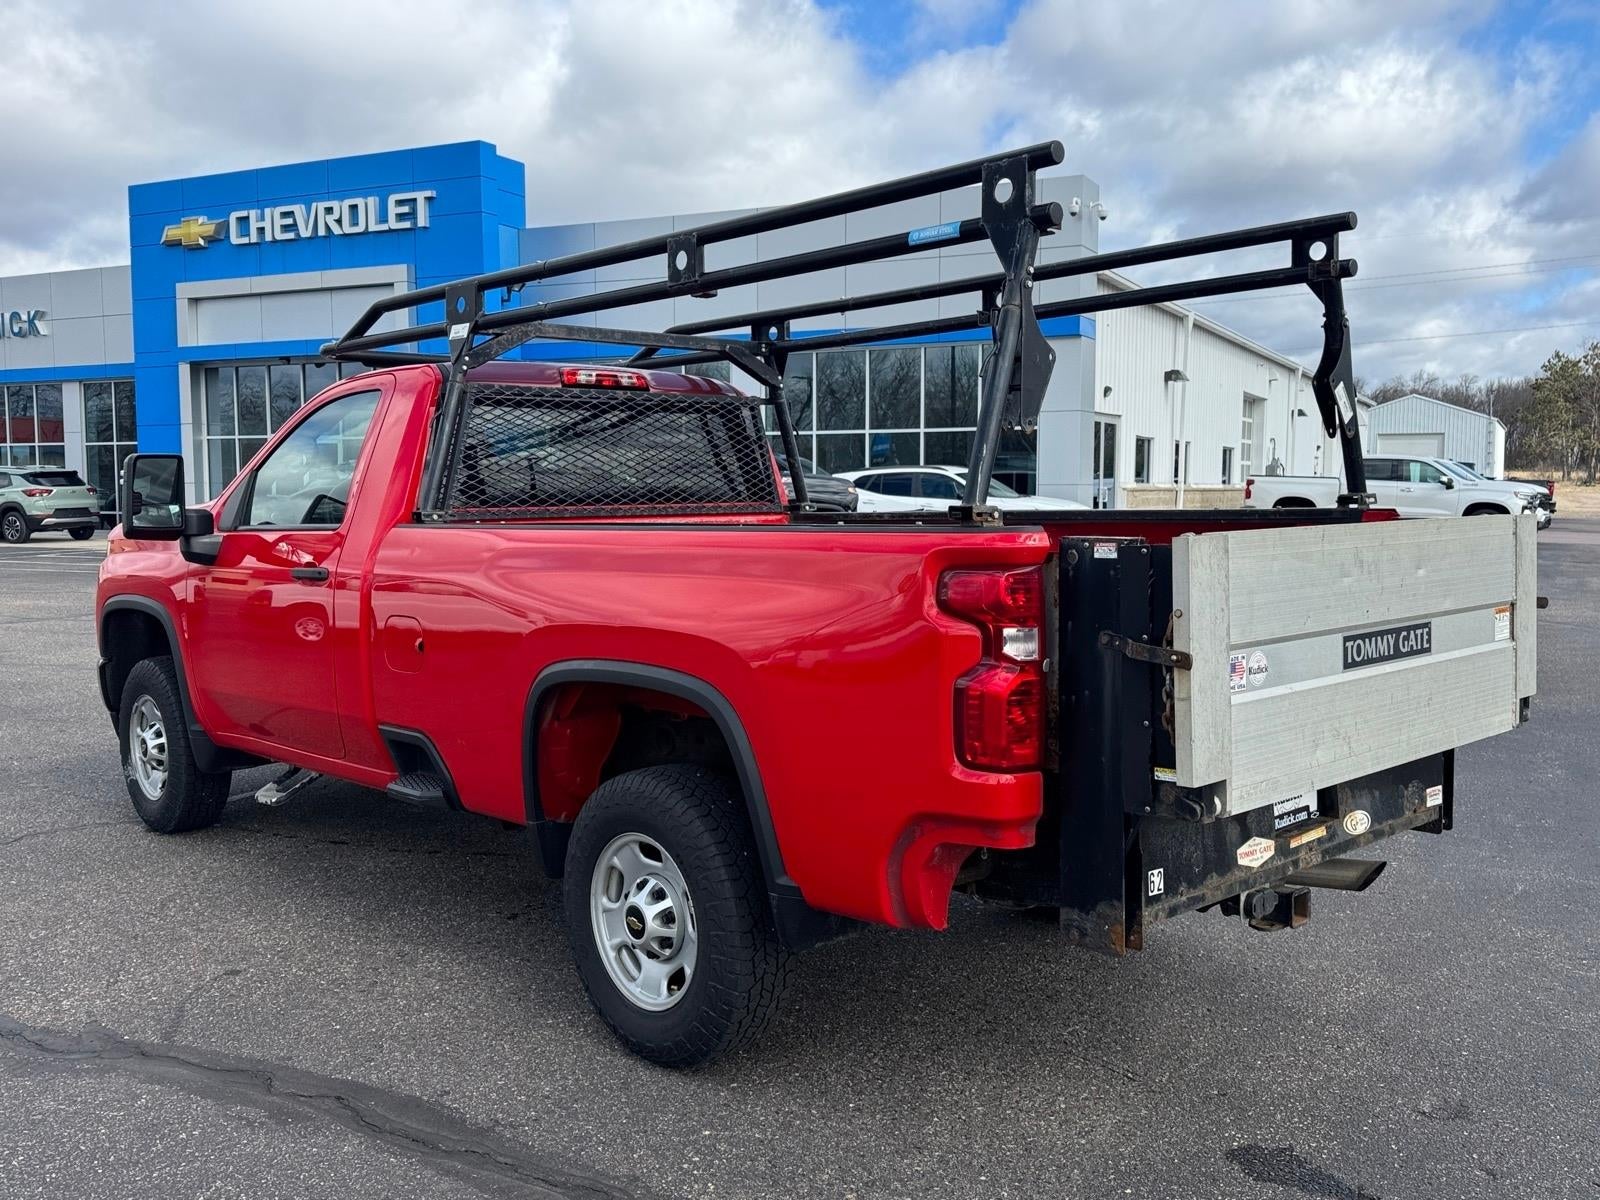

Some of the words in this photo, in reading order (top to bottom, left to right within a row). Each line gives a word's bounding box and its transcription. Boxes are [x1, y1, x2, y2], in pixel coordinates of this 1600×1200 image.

[229, 190, 436, 245] CHEVROLET
[0, 310, 46, 338] ICK
[1345, 633, 1396, 663] TOMMY
[1399, 627, 1430, 653] GATE
[1274, 811, 1308, 830] Kudick.com
[1239, 849, 1258, 860] TOMMY
[1259, 844, 1273, 854] GATE
[1149, 870, 1163, 893] 62
